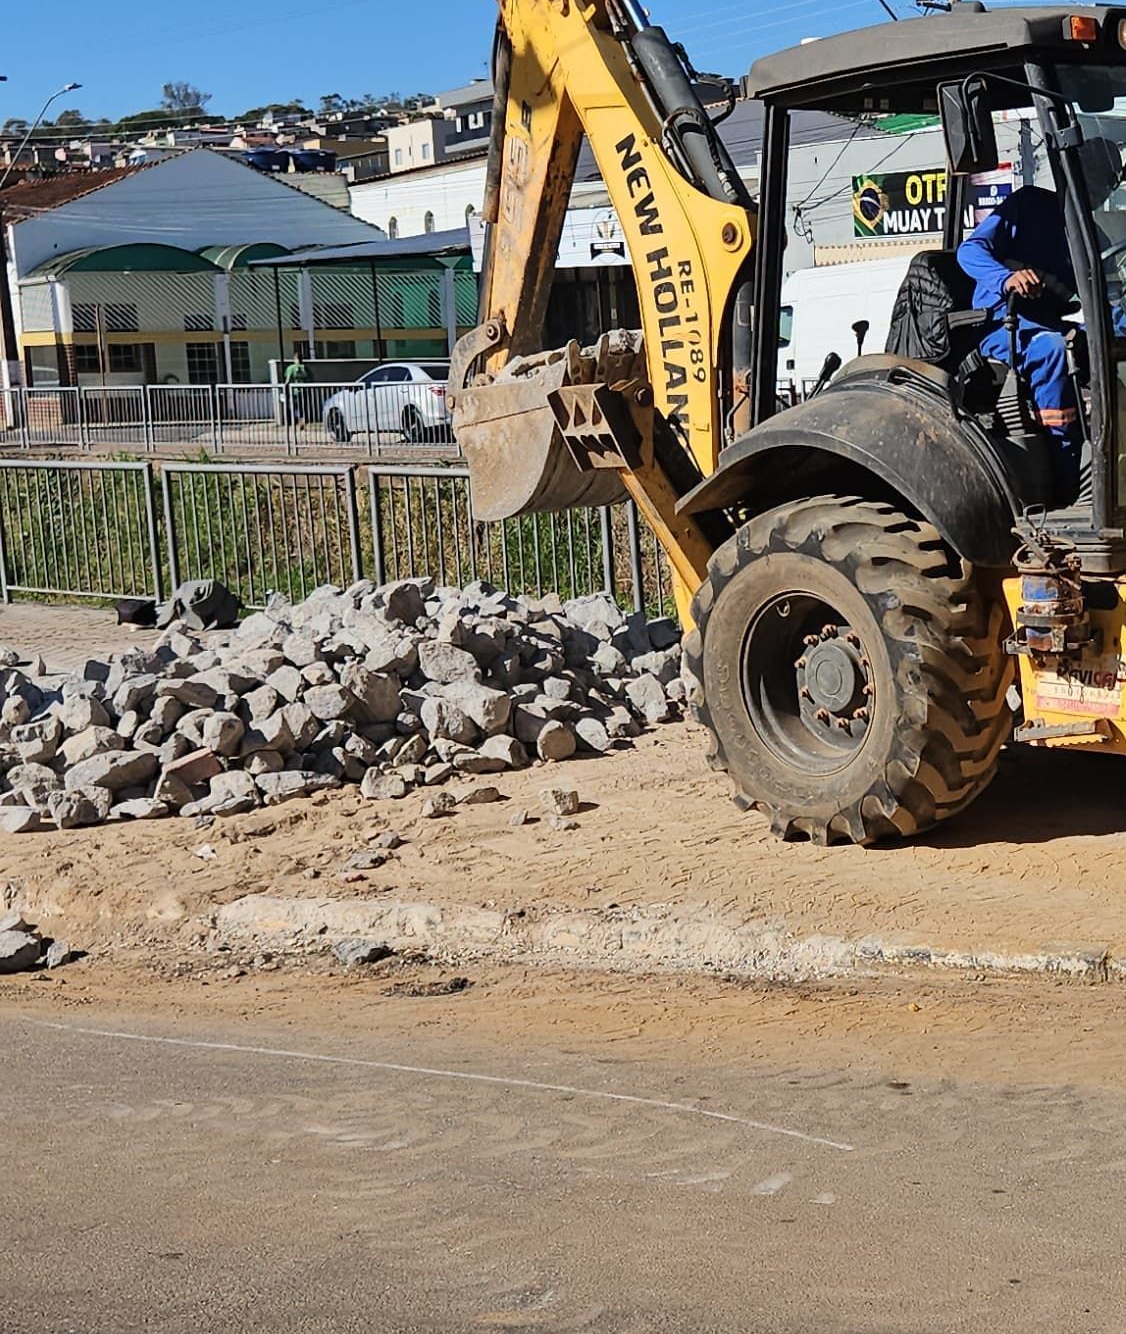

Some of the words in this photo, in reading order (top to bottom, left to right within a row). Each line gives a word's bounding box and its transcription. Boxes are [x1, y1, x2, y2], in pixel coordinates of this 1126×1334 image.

[615, 133, 664, 237] NEW
[646, 246, 690, 440] HOLLAN
[883, 207, 931, 234] MUAY
[934, 203, 975, 230] TAI
